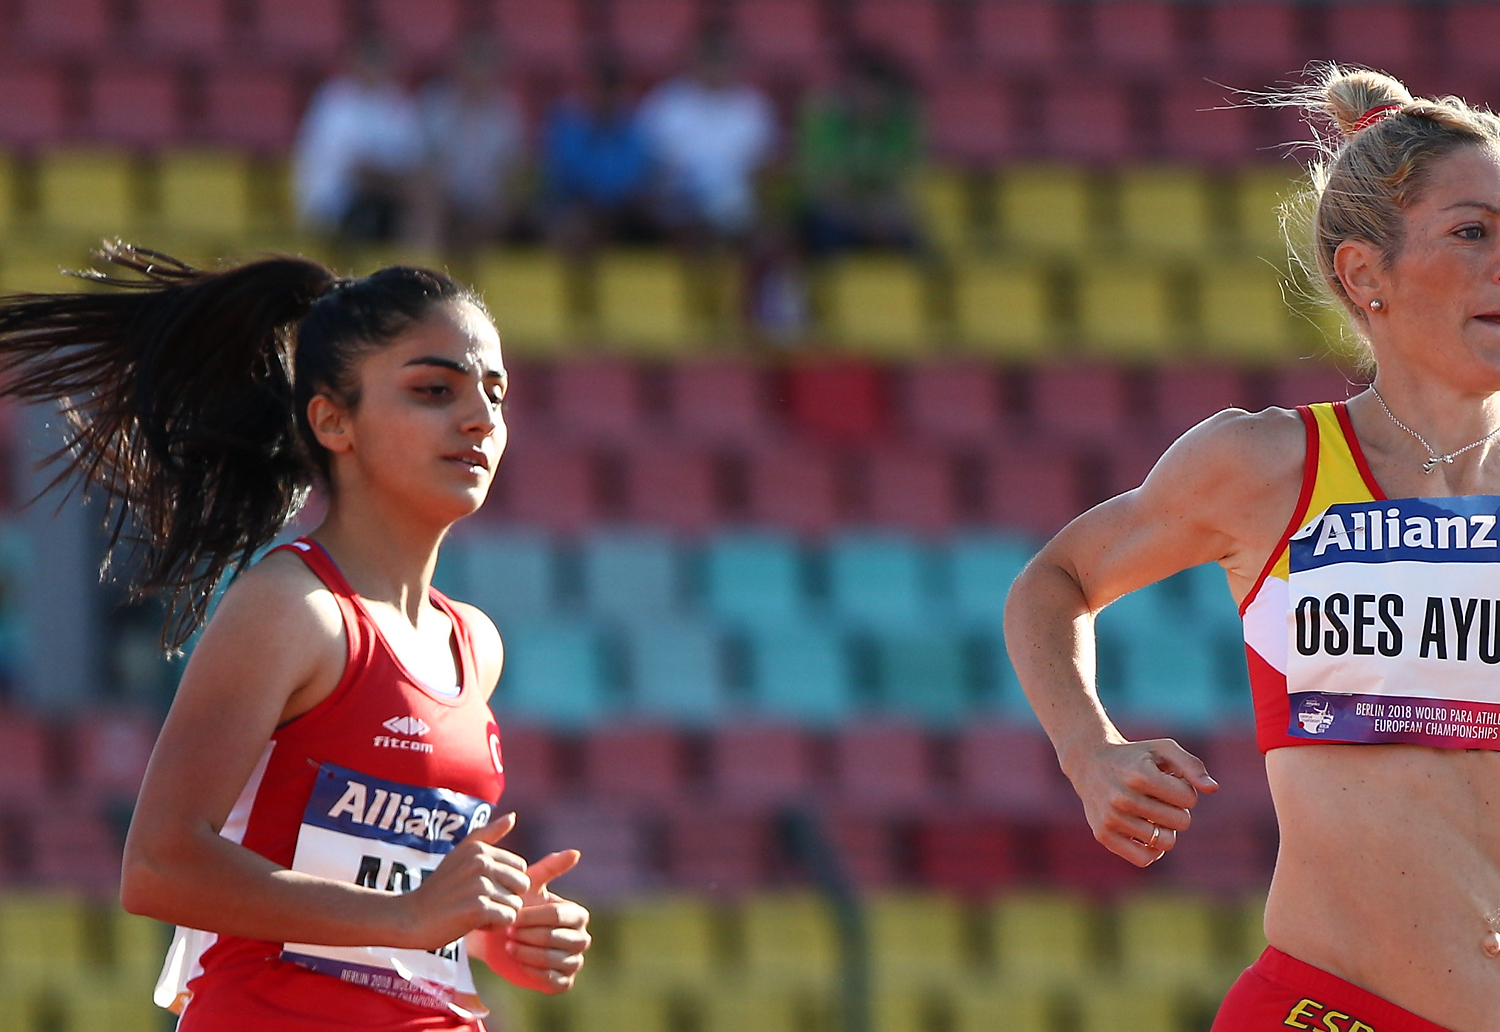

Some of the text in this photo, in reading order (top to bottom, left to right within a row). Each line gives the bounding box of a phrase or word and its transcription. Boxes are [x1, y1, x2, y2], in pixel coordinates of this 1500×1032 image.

[1312, 508, 1498, 556] Allianz
[1295, 593, 1404, 656] OSES
[1355, 703, 1384, 717] BERLIN
[1388, 705, 1412, 719] 2018
[1415, 706, 1447, 721] WOLRD
[1450, 708, 1473, 723] PARA
[1374, 719, 1498, 740] EUROPEAN CHAMPIONSHIPS
[373, 735, 433, 754] fitcom
[327, 780, 467, 842] Allianz
